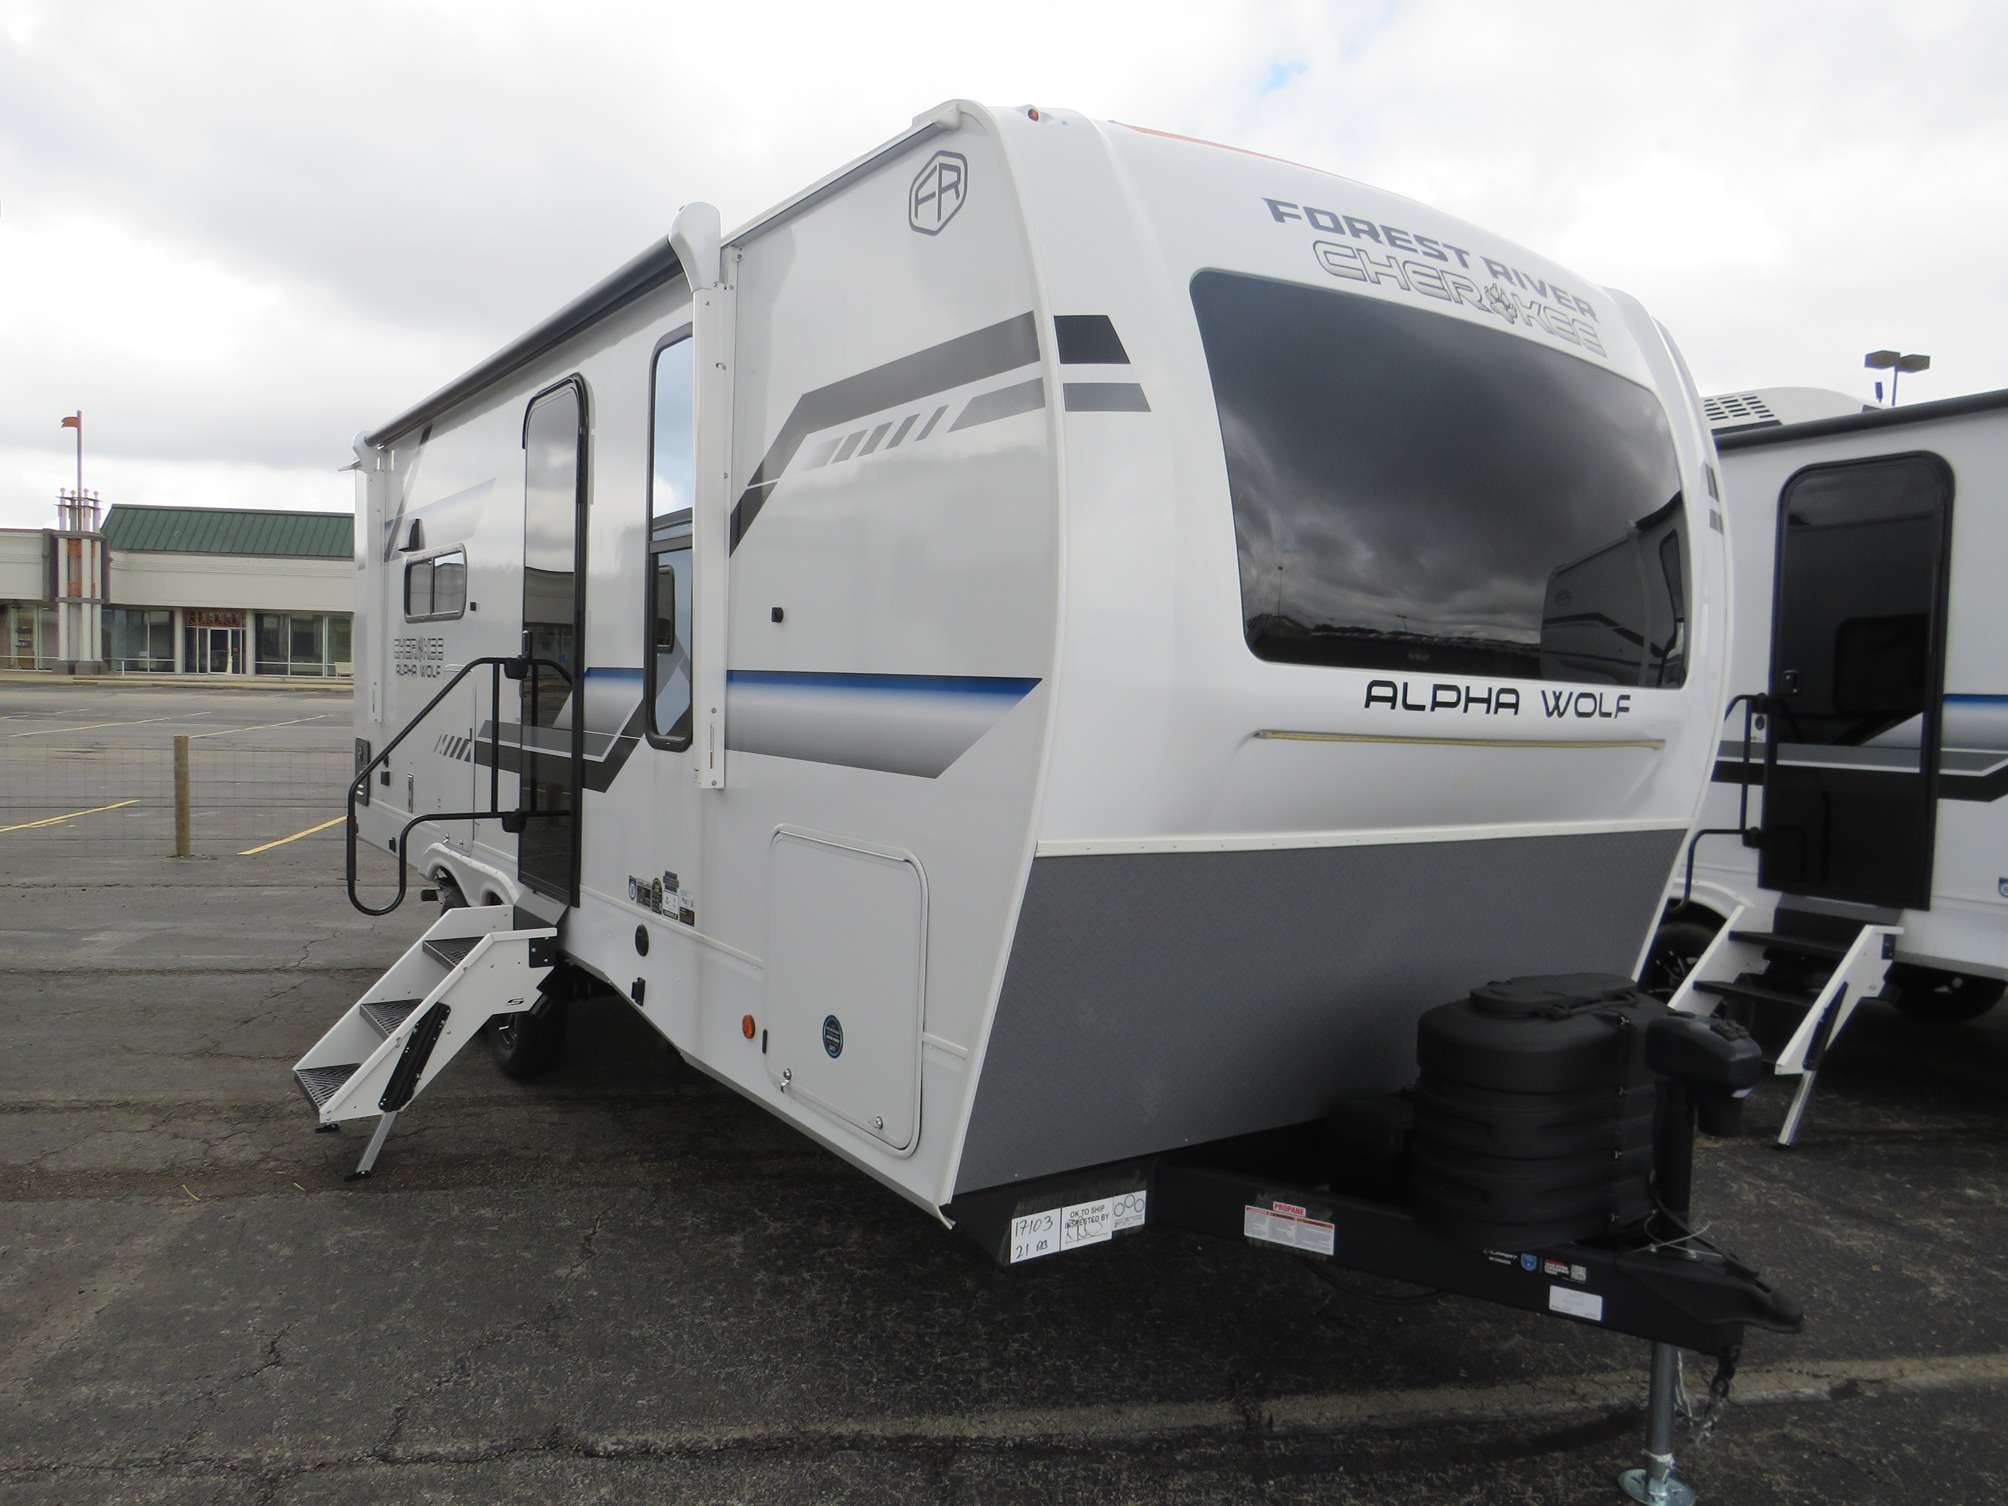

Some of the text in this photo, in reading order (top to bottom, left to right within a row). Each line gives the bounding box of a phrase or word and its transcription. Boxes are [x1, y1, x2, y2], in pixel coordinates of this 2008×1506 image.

[1262, 197, 1599, 322] FOREST RIVER
[1364, 679, 1631, 719] ALPHA WOLF
[1070, 1211, 1080, 1219] OK
[1081, 1208, 1090, 1216] TO
[1015, 1215, 1053, 1237] 17103
[1016, 1244, 1029, 1259] 21
